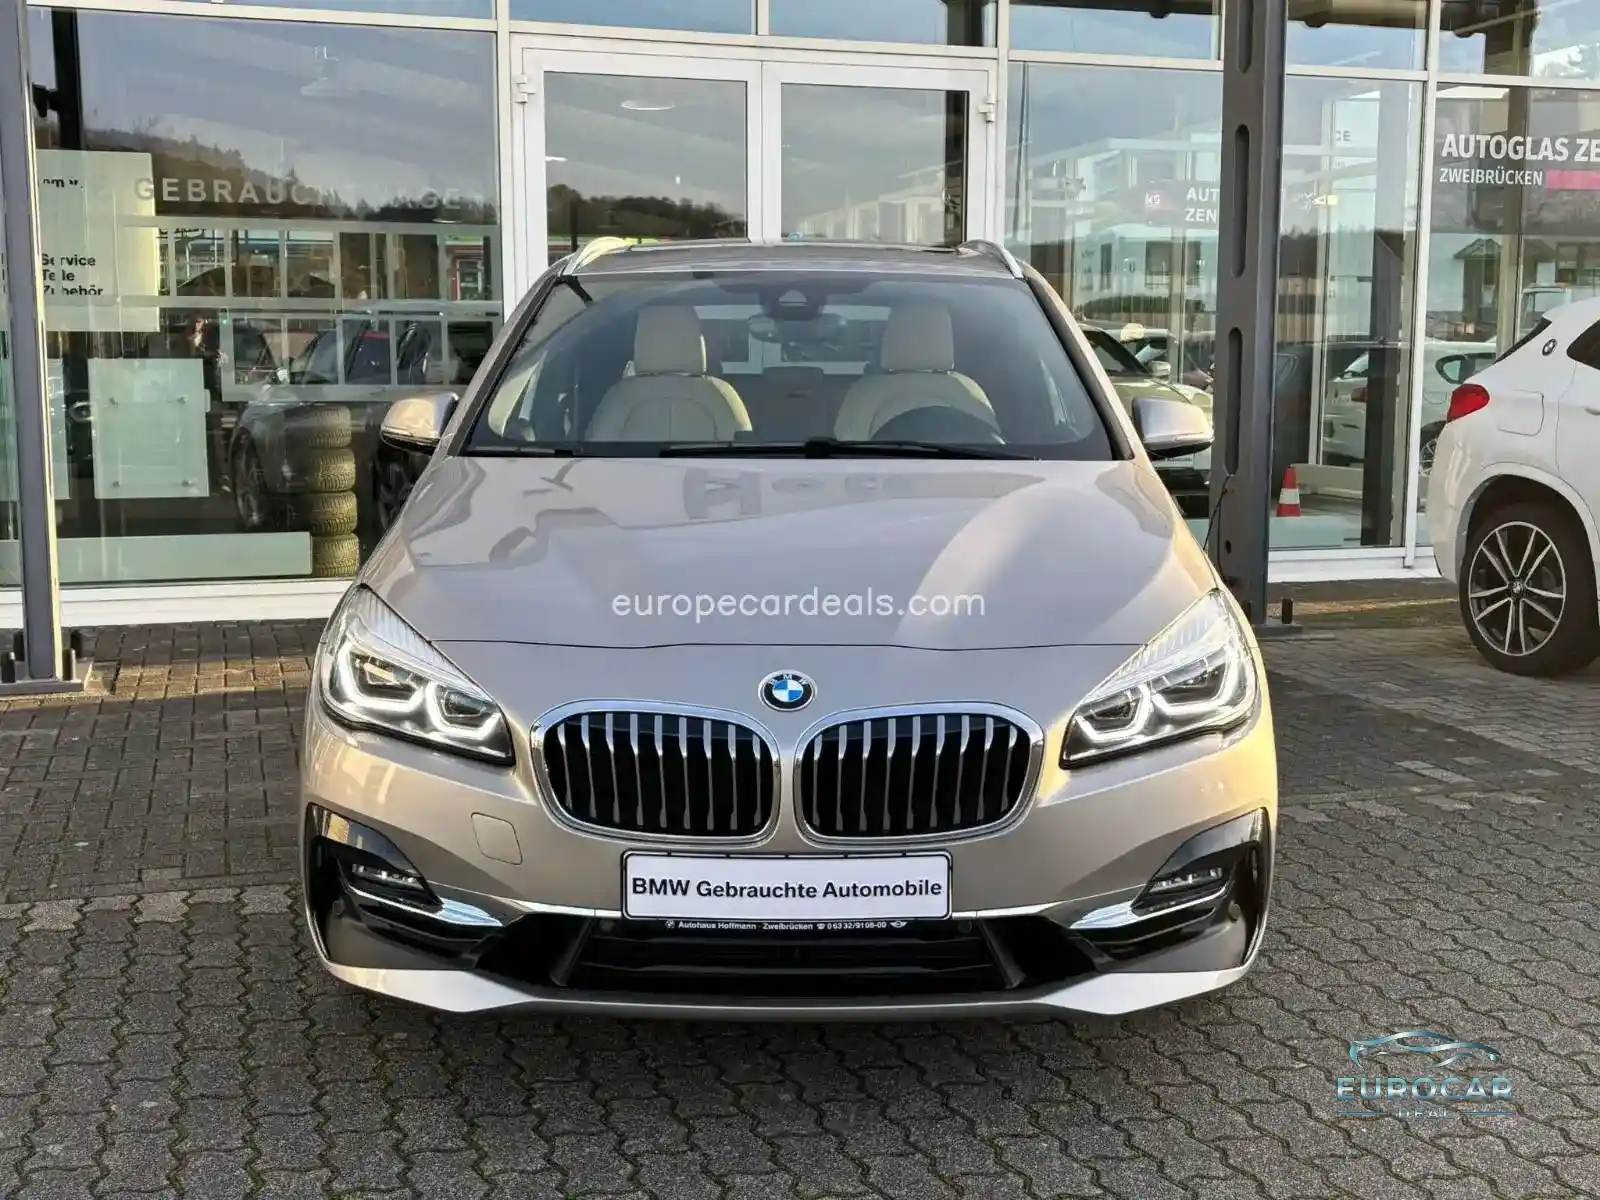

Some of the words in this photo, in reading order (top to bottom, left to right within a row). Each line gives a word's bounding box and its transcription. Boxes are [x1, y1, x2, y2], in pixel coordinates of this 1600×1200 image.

[1441, 133, 1569, 162] AUTOGLAS
[1574, 137, 1600, 163] ZE
[1439, 166, 1543, 186] ZWEIBRÜCKEN
[1186, 187, 1220, 202] AUT
[1184, 208, 1217, 223] ZEN
[42, 269, 75, 281] Tele
[631, 877, 691, 896] BMW
[696, 880, 818, 898] Gebrauchte
[822, 879, 942, 898] Automobile
[678, 921, 717, 929] Autohaus
[718, 922, 757, 930] Hoffmann
[762, 922, 813, 930] Zweibrücken
